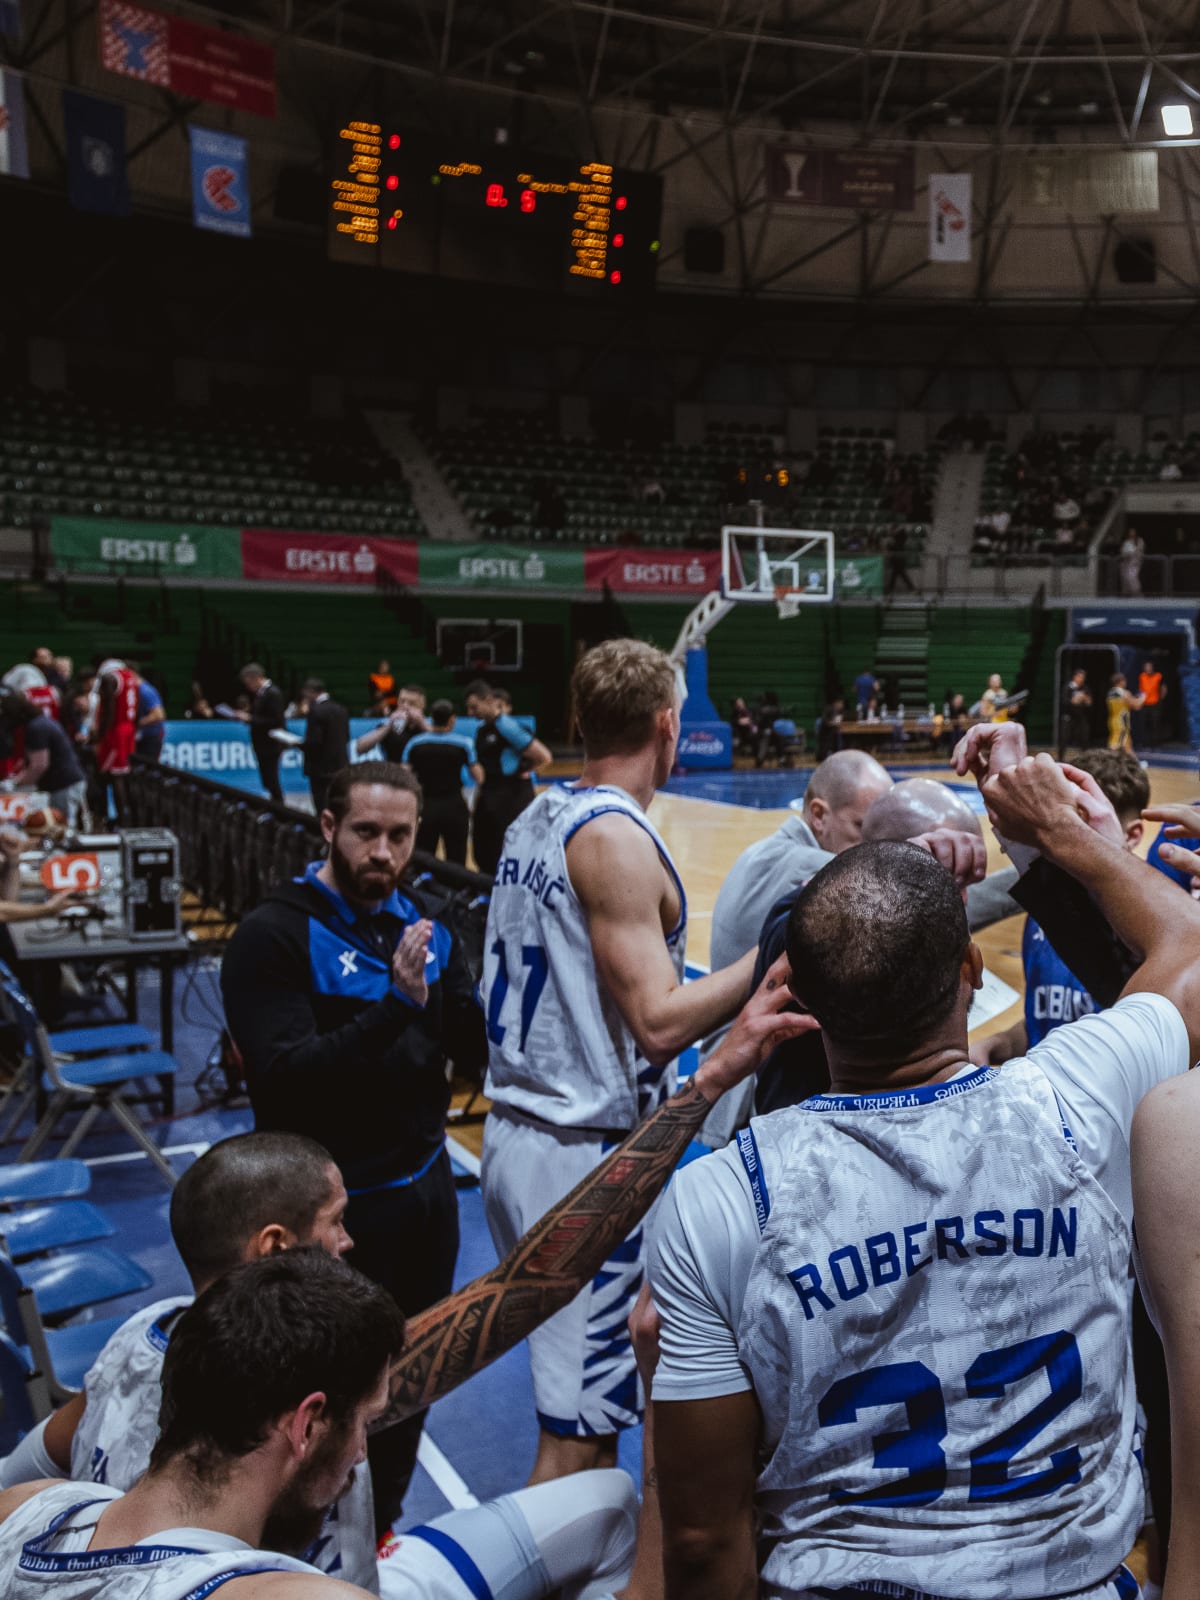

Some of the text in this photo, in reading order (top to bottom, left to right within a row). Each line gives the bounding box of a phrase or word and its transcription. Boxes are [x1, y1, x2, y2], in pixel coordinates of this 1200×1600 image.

[100, 537, 170, 564] ERSTE
[285, 548, 351, 573] ERSTE
[458, 556, 520, 581] ERSTE
[623, 563, 682, 585] ERSTE
[786, 1207, 1078, 1320] ROBERSON
[817, 1329, 1083, 1508] 32
